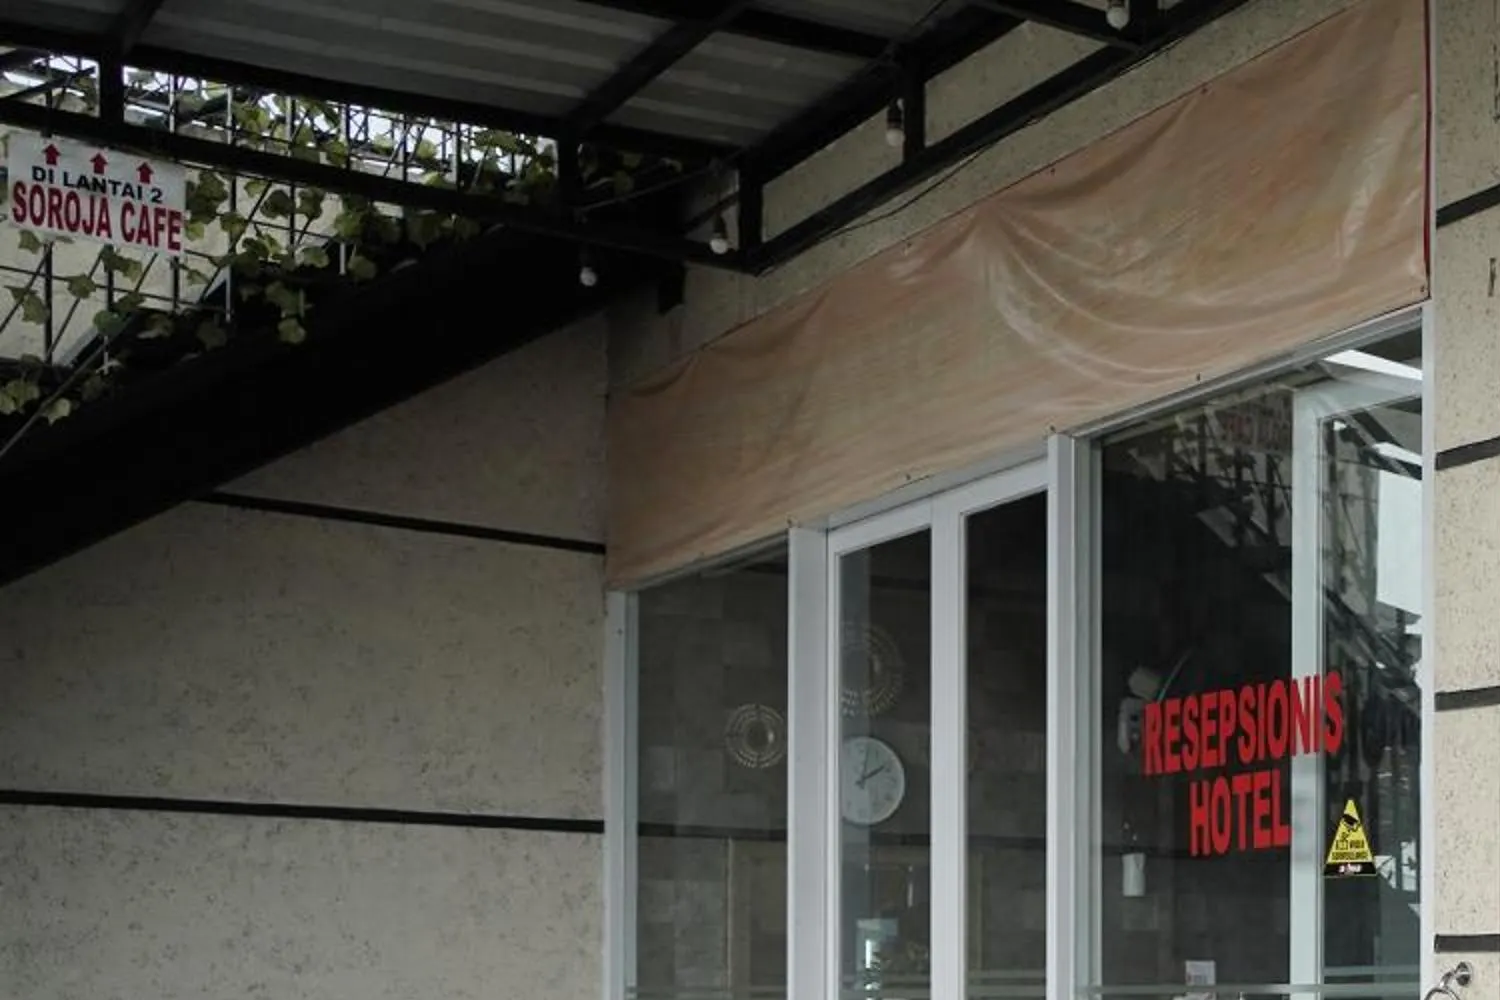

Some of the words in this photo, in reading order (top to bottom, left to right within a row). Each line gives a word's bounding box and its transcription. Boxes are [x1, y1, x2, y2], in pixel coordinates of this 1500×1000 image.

[11, 180, 113, 240] SOROJA
[120, 201, 183, 252] CAFE
[31, 165, 55, 185] DI
[63, 171, 143, 199] LANTAI
[150, 187, 163, 204] 2
[1144, 671, 1343, 774] RESEPSIONIS
[1190, 769, 1292, 855] HOTEL
